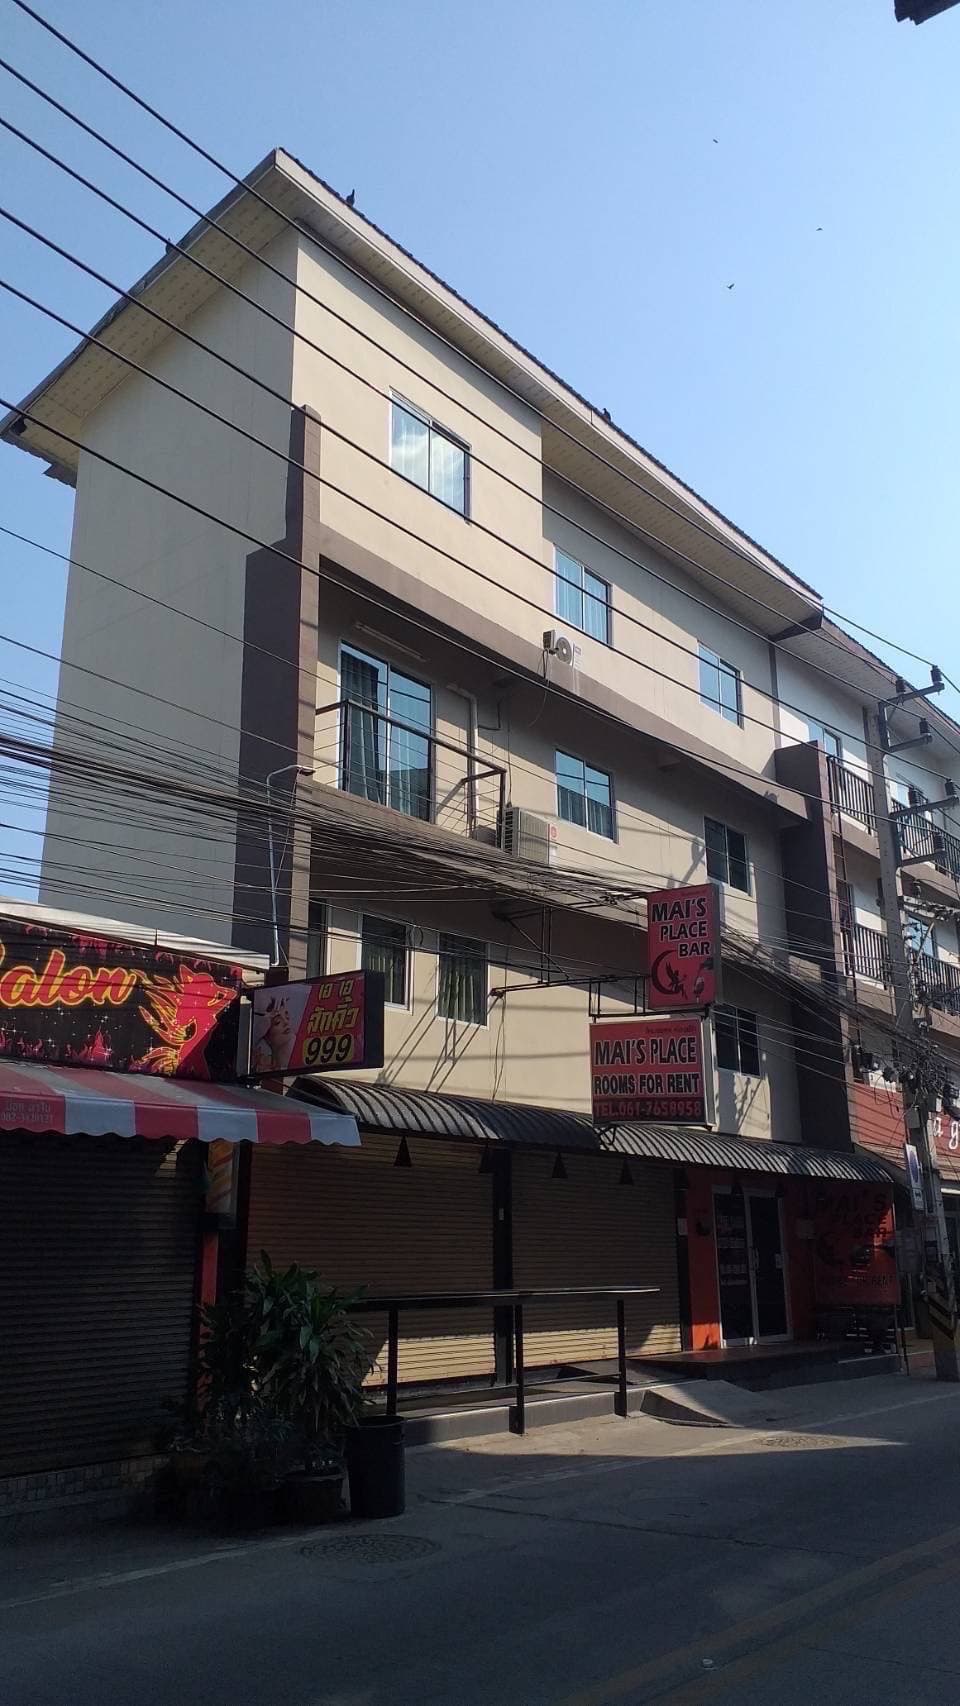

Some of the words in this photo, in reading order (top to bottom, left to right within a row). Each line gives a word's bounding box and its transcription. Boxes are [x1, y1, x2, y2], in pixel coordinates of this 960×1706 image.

[652, 897, 707, 923] MAI'S
[660, 920, 708, 941] PLACE
[679, 941, 711, 957] BAR
[0, 938, 137, 1006] alon
[304, 1033, 352, 1065] 999
[594, 1037, 646, 1065] MAI'S
[650, 1035, 697, 1064] PLACE
[593, 1074, 636, 1096] ROOMS
[639, 1073, 663, 1095] FOR
[667, 1072, 701, 1094] RENT
